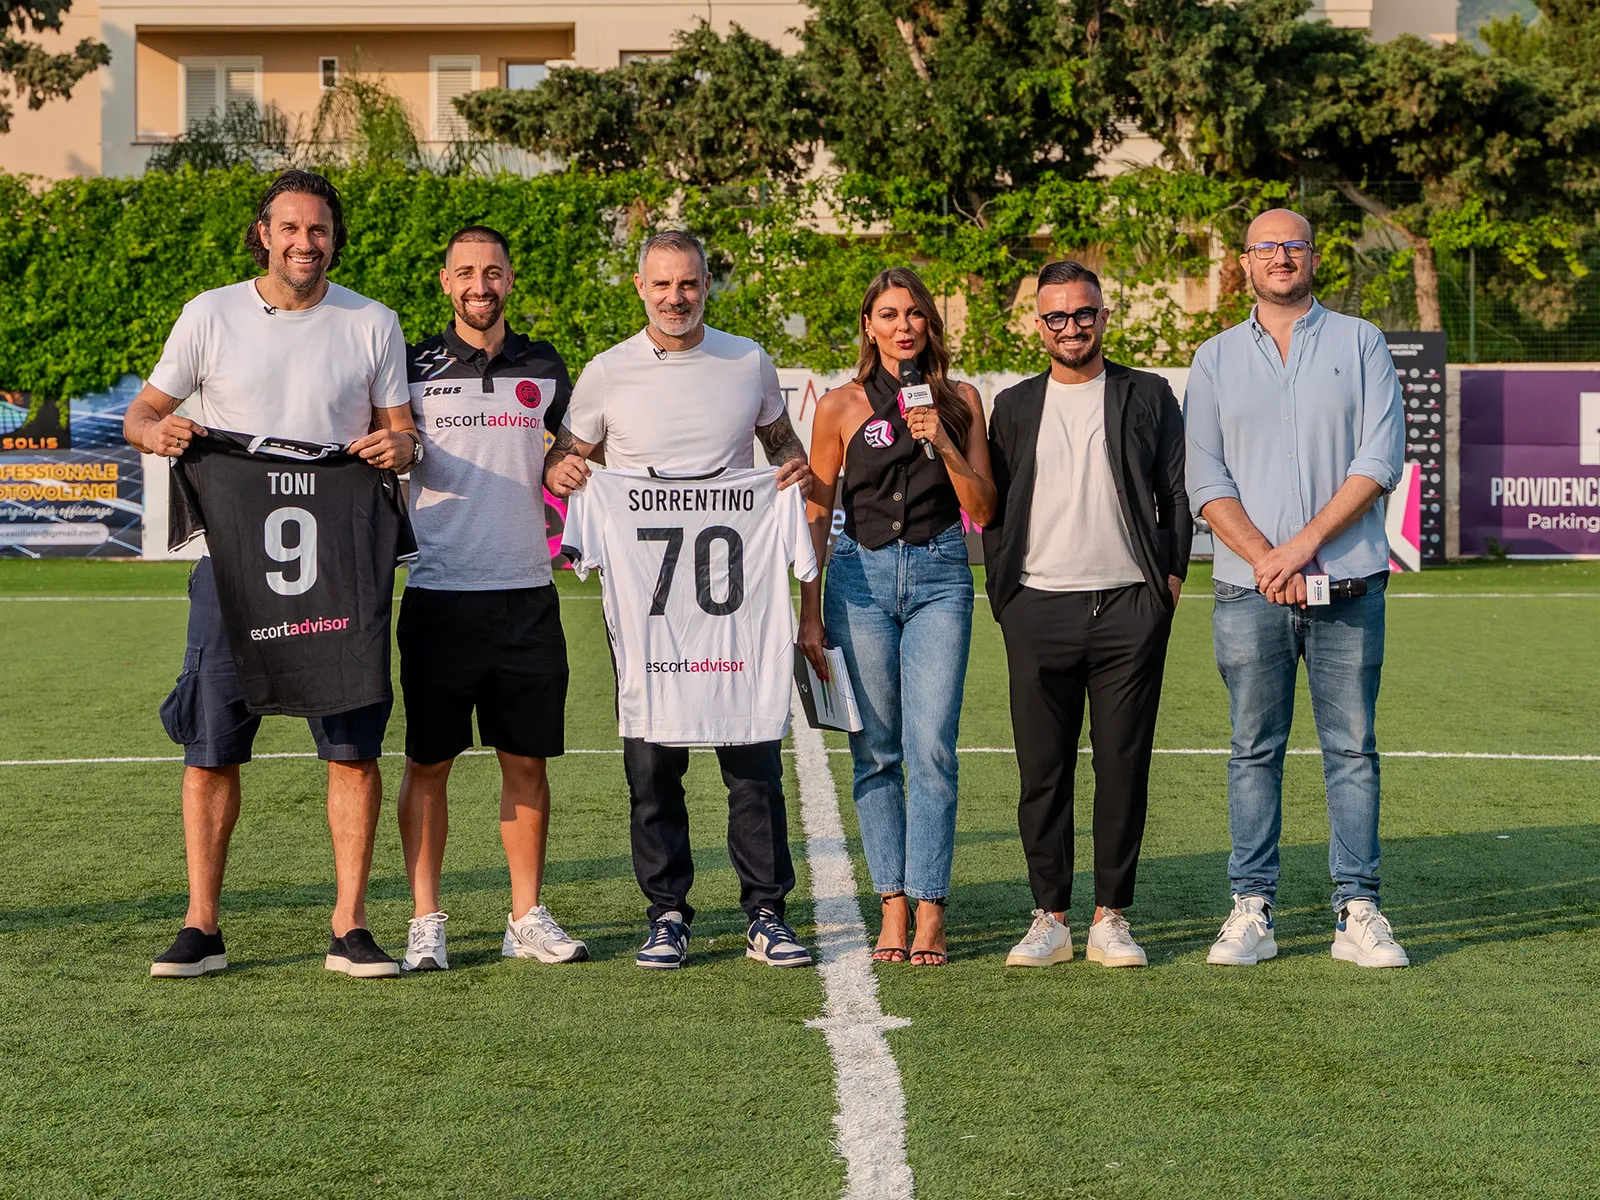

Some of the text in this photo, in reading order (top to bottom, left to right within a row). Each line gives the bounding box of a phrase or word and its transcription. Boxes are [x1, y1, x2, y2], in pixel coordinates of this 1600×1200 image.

[423, 386, 462, 398] Zeus
[435, 412, 541, 429] escortadvisor
[2, 437, 58, 449] SOLIS
[0, 464, 118, 480] FESSIONALE
[267, 472, 316, 495] TONI
[1491, 477, 1600, 507] PROVIDENC
[628, 489, 755, 512] SORRENTINO
[1528, 512, 1600, 533] Parking
[264, 506, 318, 596] 9
[636, 525, 744, 617] 70
[250, 616, 350, 641] escortadvisor
[645, 657, 745, 673] escortadvisor
